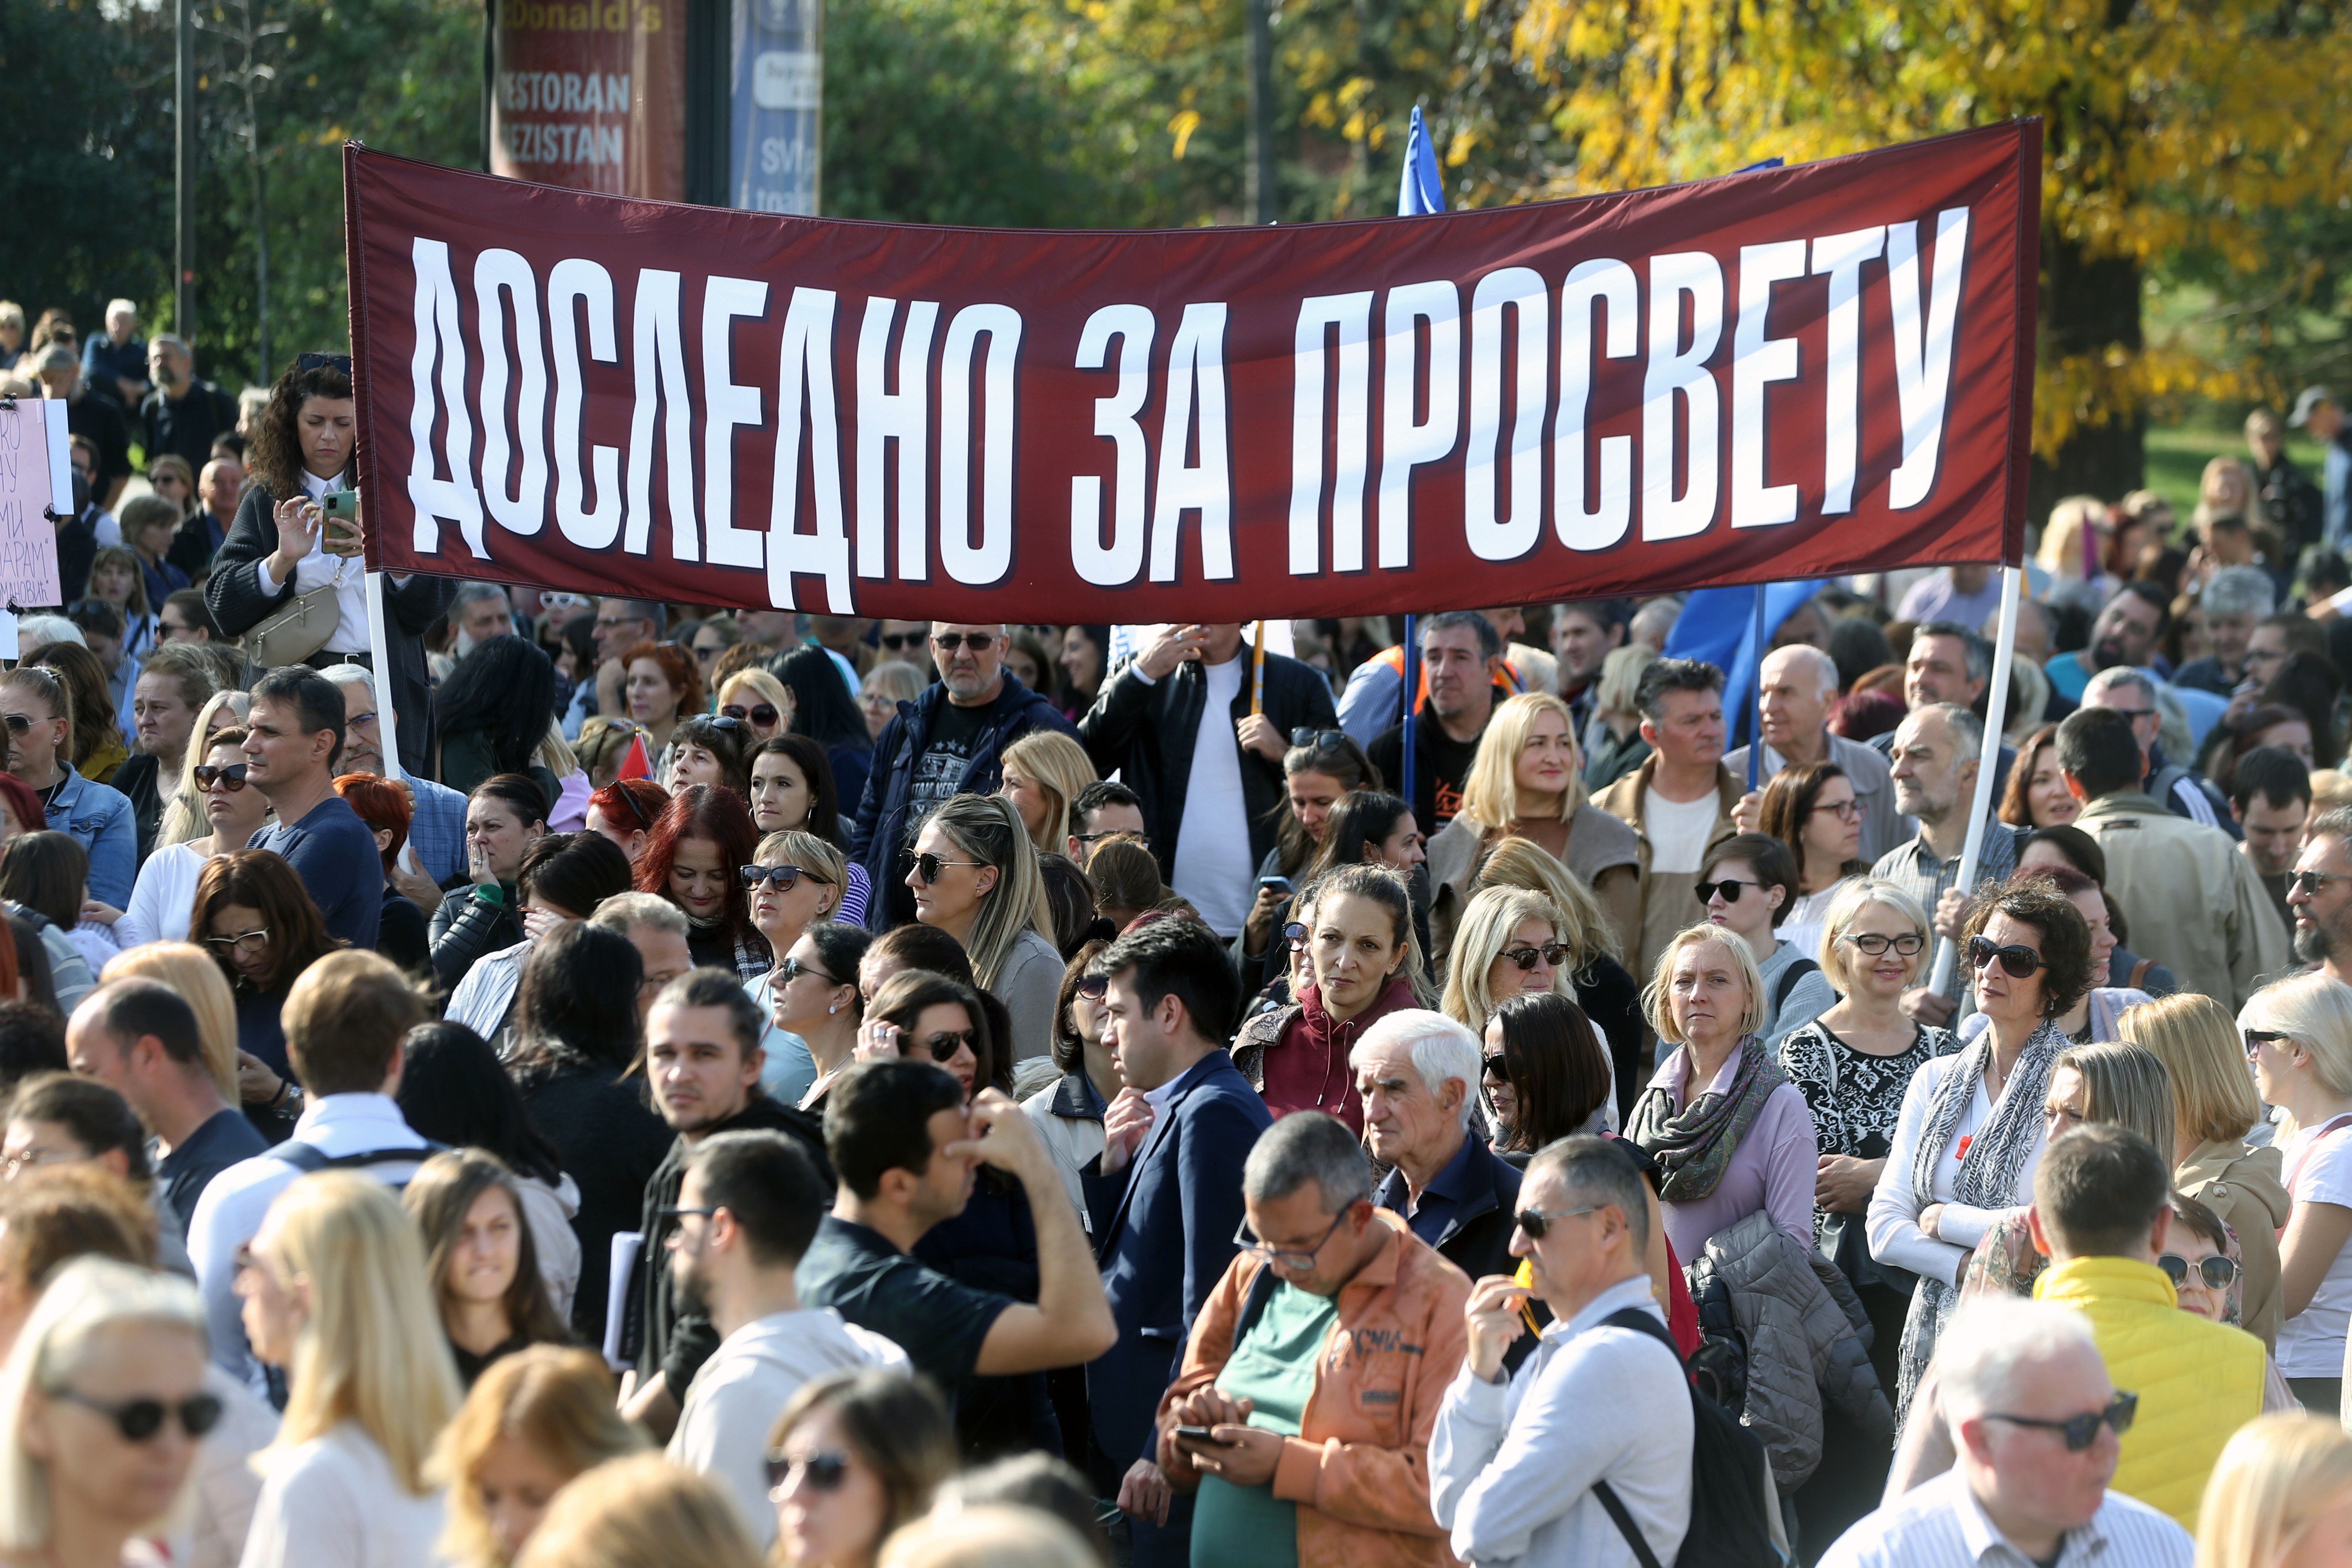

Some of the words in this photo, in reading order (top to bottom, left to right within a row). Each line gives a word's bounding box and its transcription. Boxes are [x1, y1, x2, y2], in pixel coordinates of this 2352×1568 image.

[0, 412, 20, 451] КО
[407, 236, 1023, 615] ДОСЛЕДНО
[1070, 302, 1234, 586] ЗА
[1289, 206, 1970, 575] ПРОСВЕТУ
